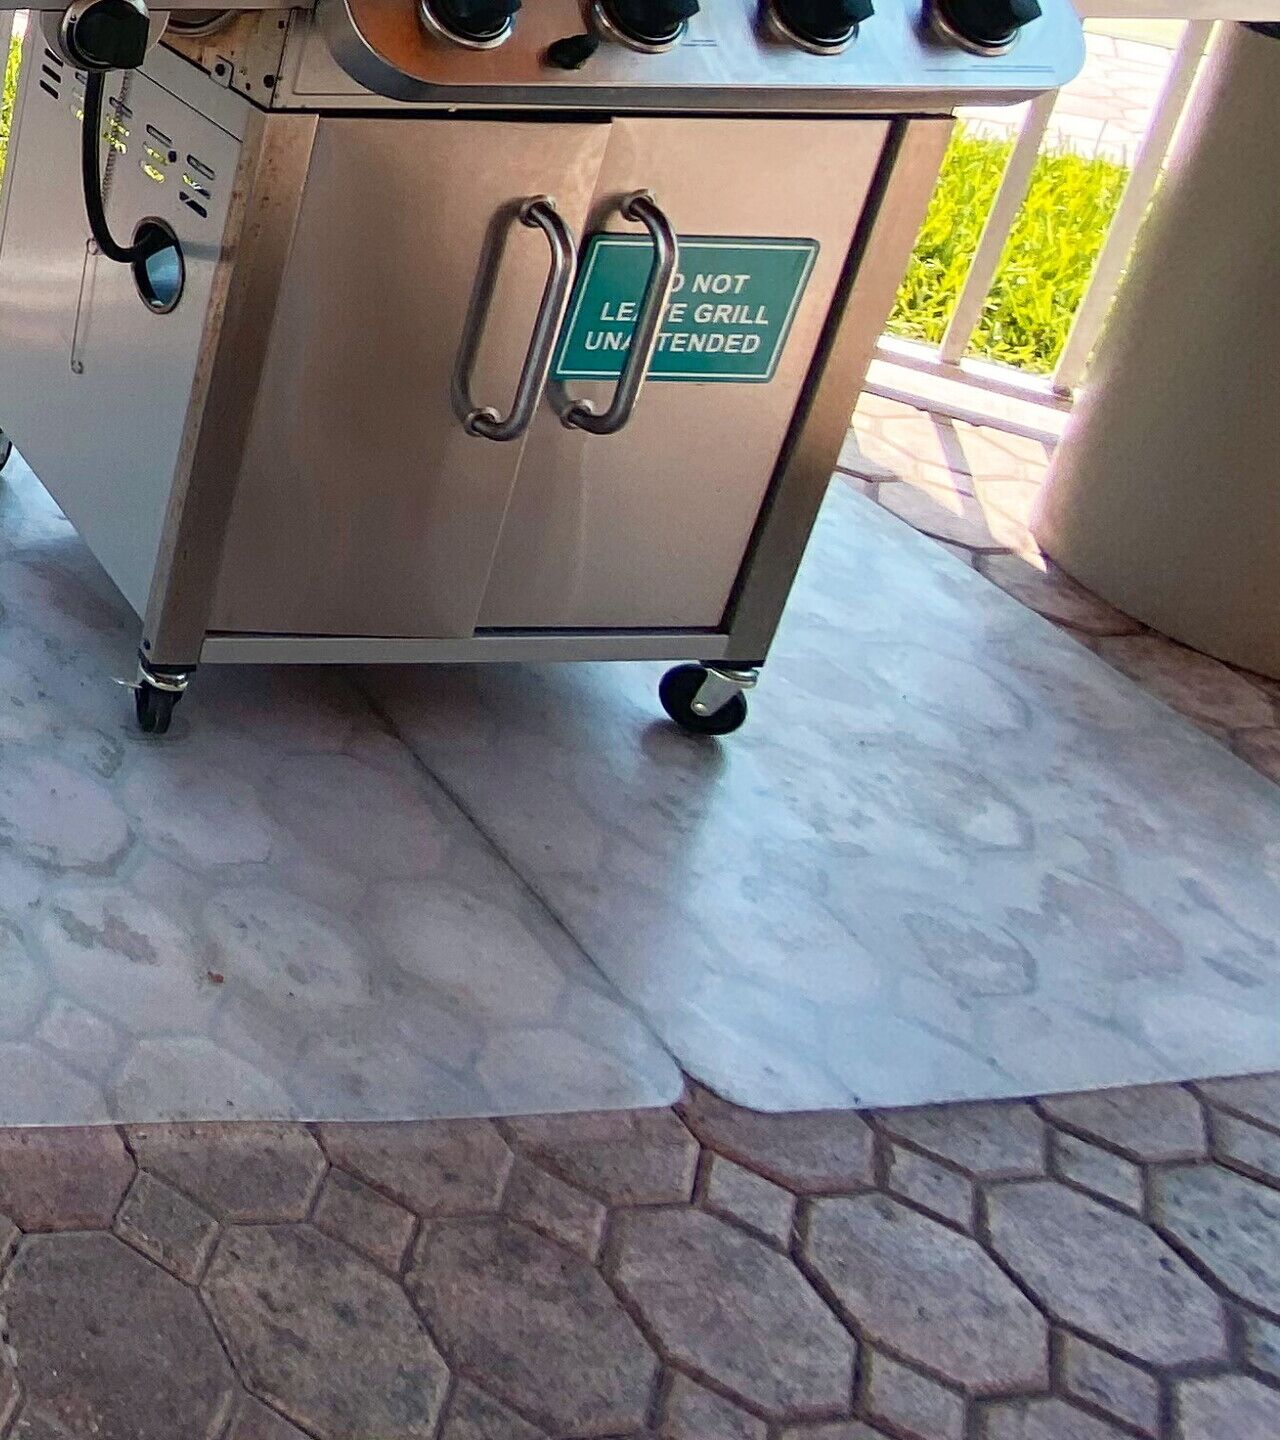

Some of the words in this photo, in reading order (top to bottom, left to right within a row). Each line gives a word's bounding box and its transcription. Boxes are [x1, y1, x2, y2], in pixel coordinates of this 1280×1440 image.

[691, 273, 751, 294] NOT
[600, 301, 688, 323] LEE
[694, 303, 769, 325] GRILL
[584, 330, 761, 354] UNTENDED
